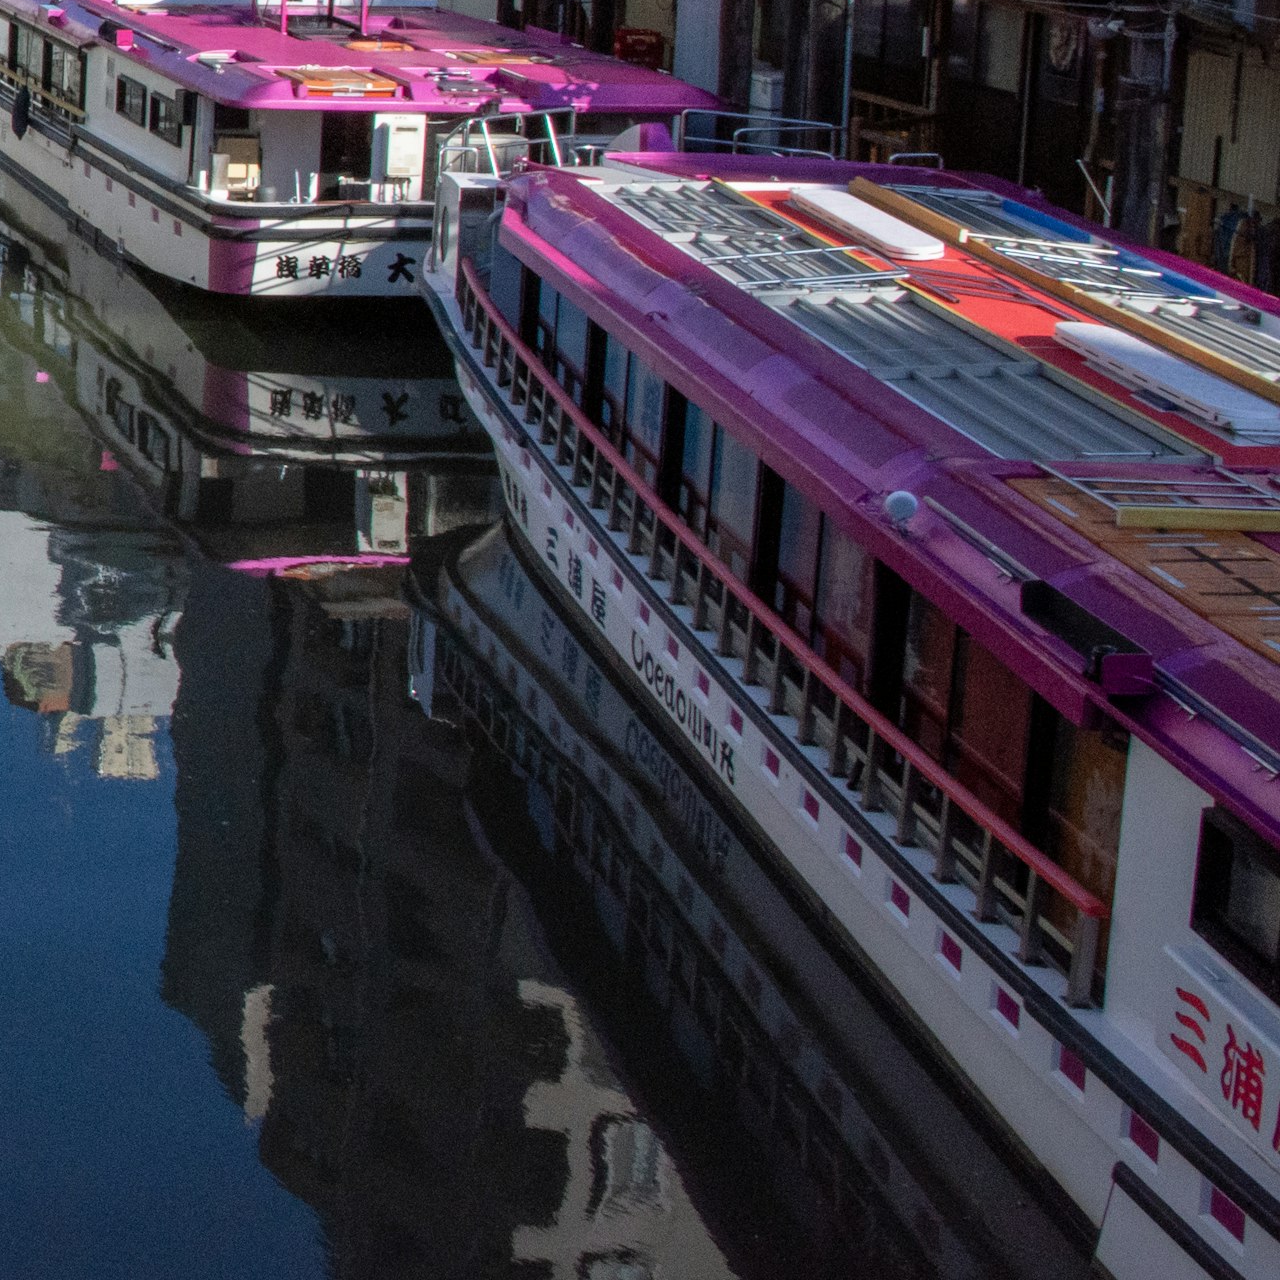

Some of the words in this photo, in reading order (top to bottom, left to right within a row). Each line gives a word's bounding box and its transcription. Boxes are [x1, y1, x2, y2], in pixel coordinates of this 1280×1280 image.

[276, 255, 363, 279] 浅草橋
[388, 252, 416, 283] 大
[1170, 986, 1280, 1152] 三浦
